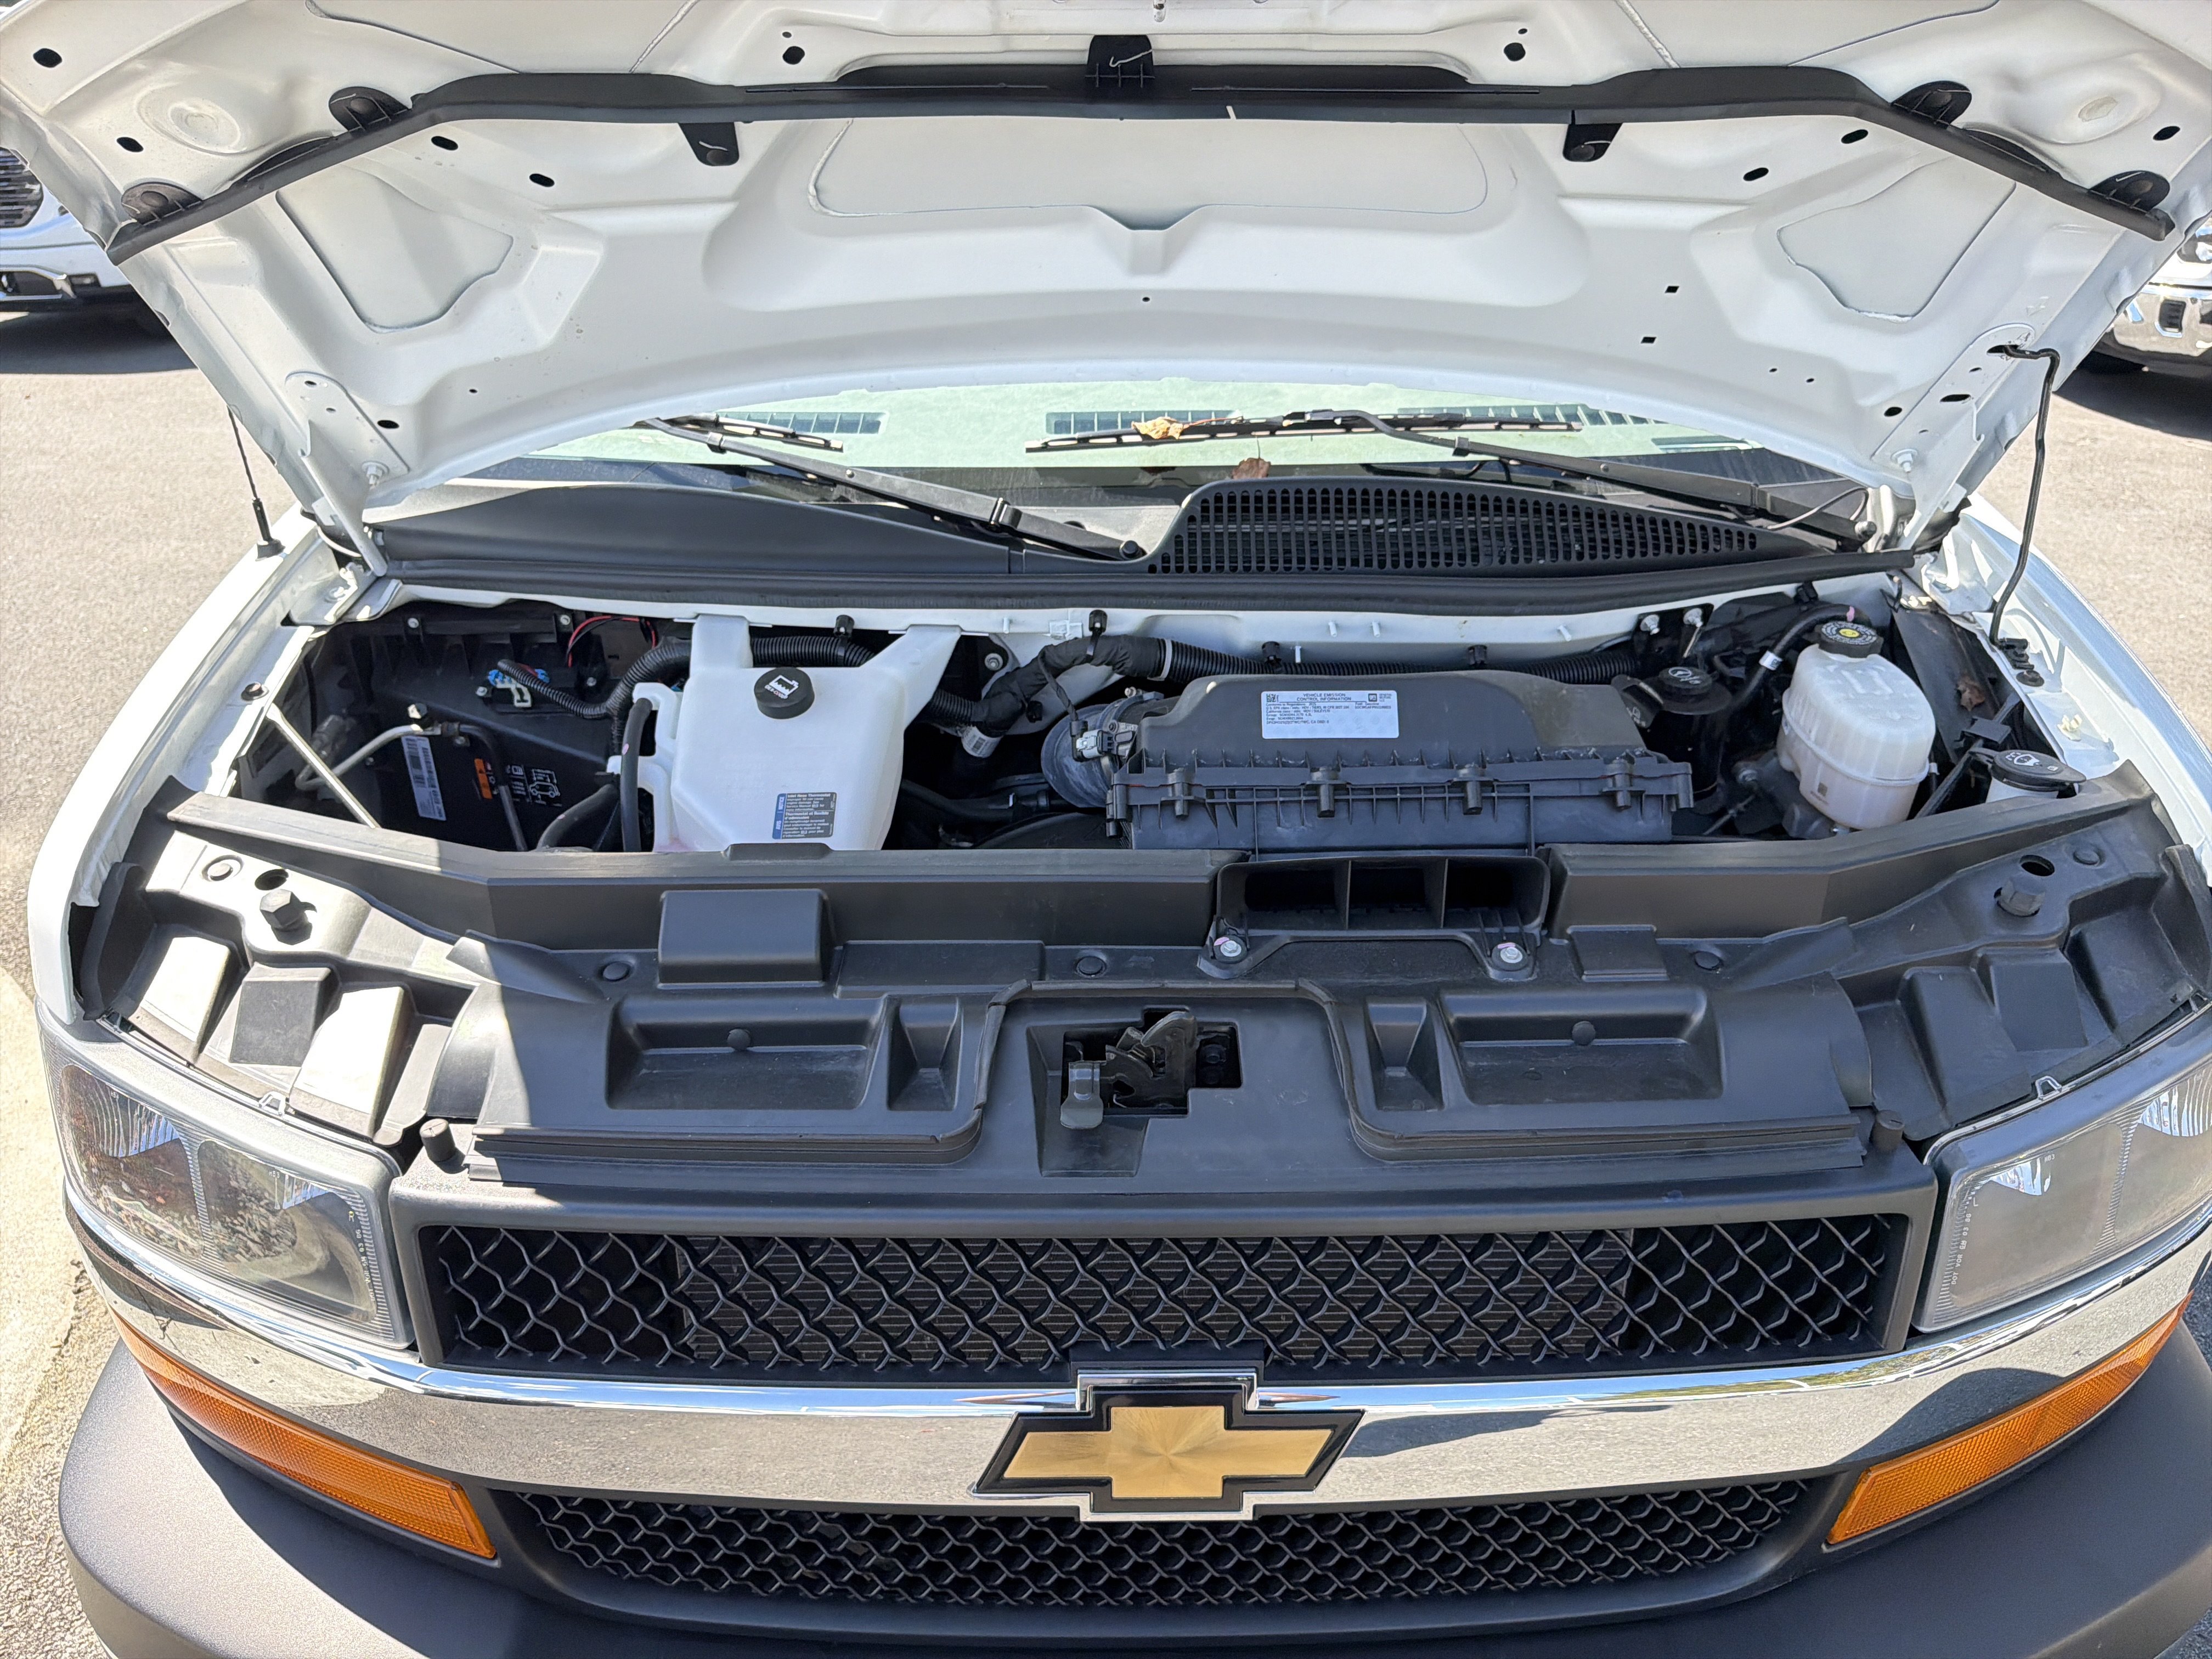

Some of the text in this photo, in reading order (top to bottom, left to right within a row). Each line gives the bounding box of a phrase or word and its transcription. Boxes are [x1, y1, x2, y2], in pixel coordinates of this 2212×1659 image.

[2044, 1154, 2055, 1163] HB3
[1973, 1197, 1978, 1207] L
[1951, 1272, 1959, 1285] DOT
[1962, 1227, 1969, 1236] 03
